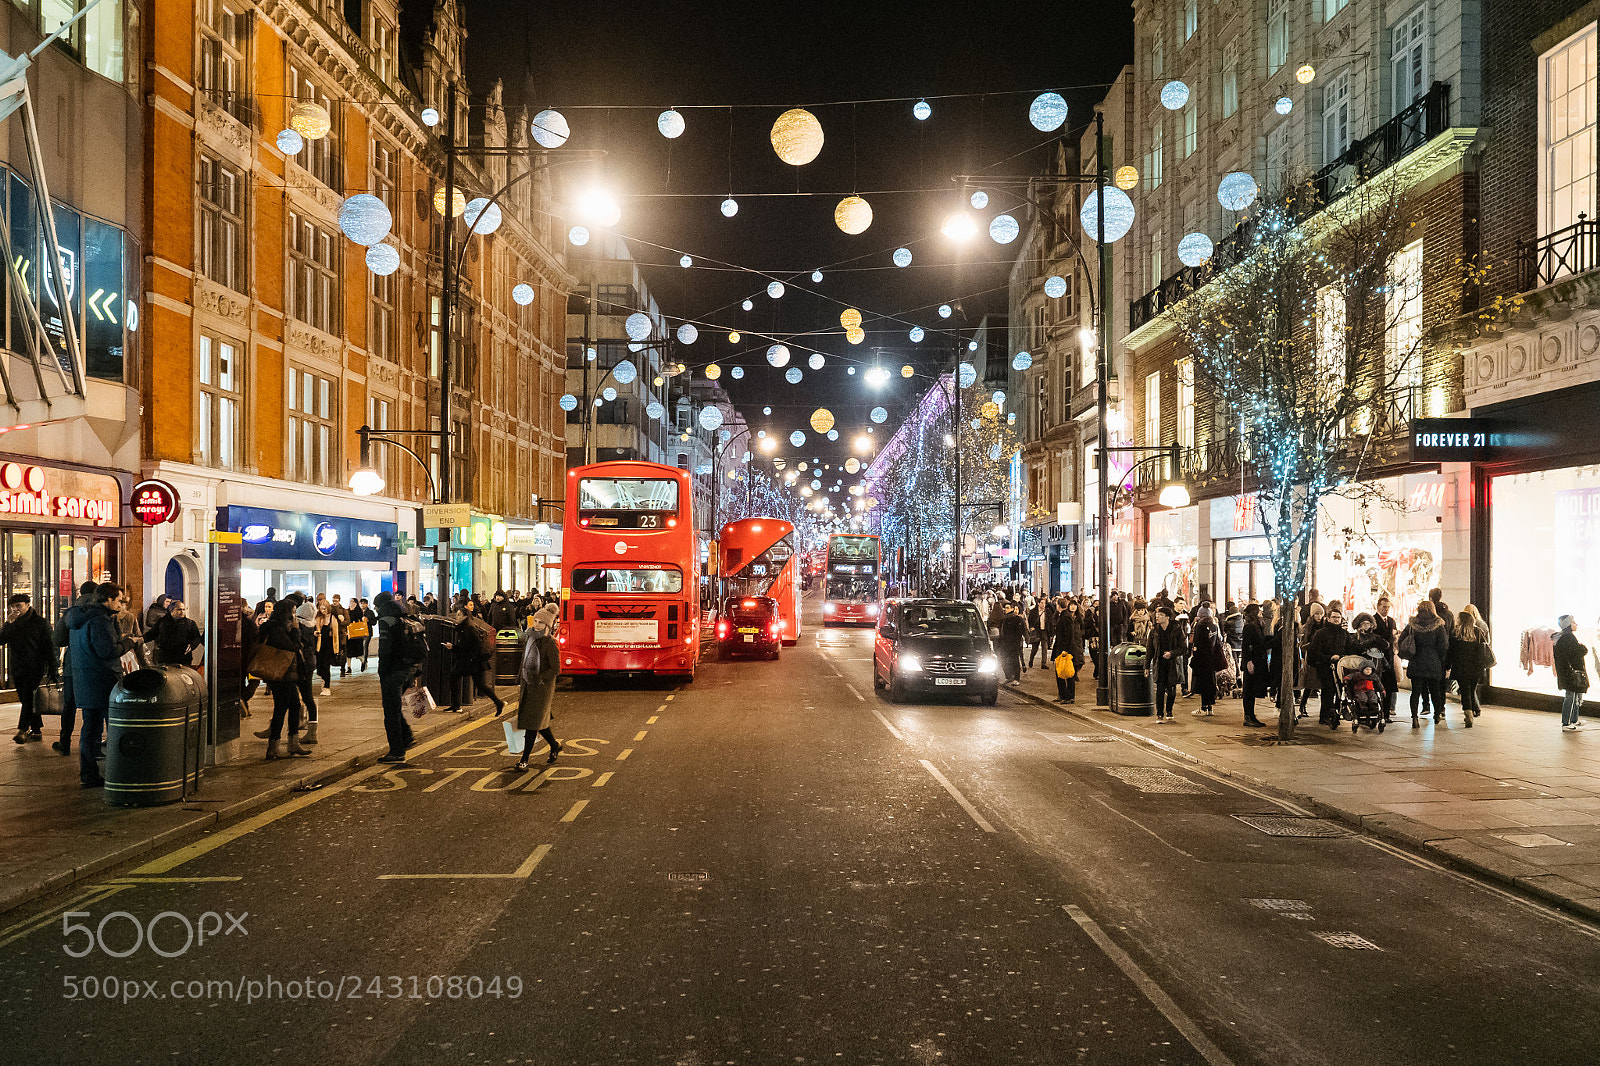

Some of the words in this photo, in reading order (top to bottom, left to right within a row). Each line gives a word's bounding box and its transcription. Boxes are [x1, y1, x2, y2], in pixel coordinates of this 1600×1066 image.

[1415, 433, 1469, 446] FOREVER
[1473, 433, 1485, 446] 21
[1410, 482, 1445, 508] H&M
[640, 515, 657, 527] 23
[752, 564, 766, 575] 390
[863, 565, 873, 573] 23
[350, 767, 594, 793] STOP
